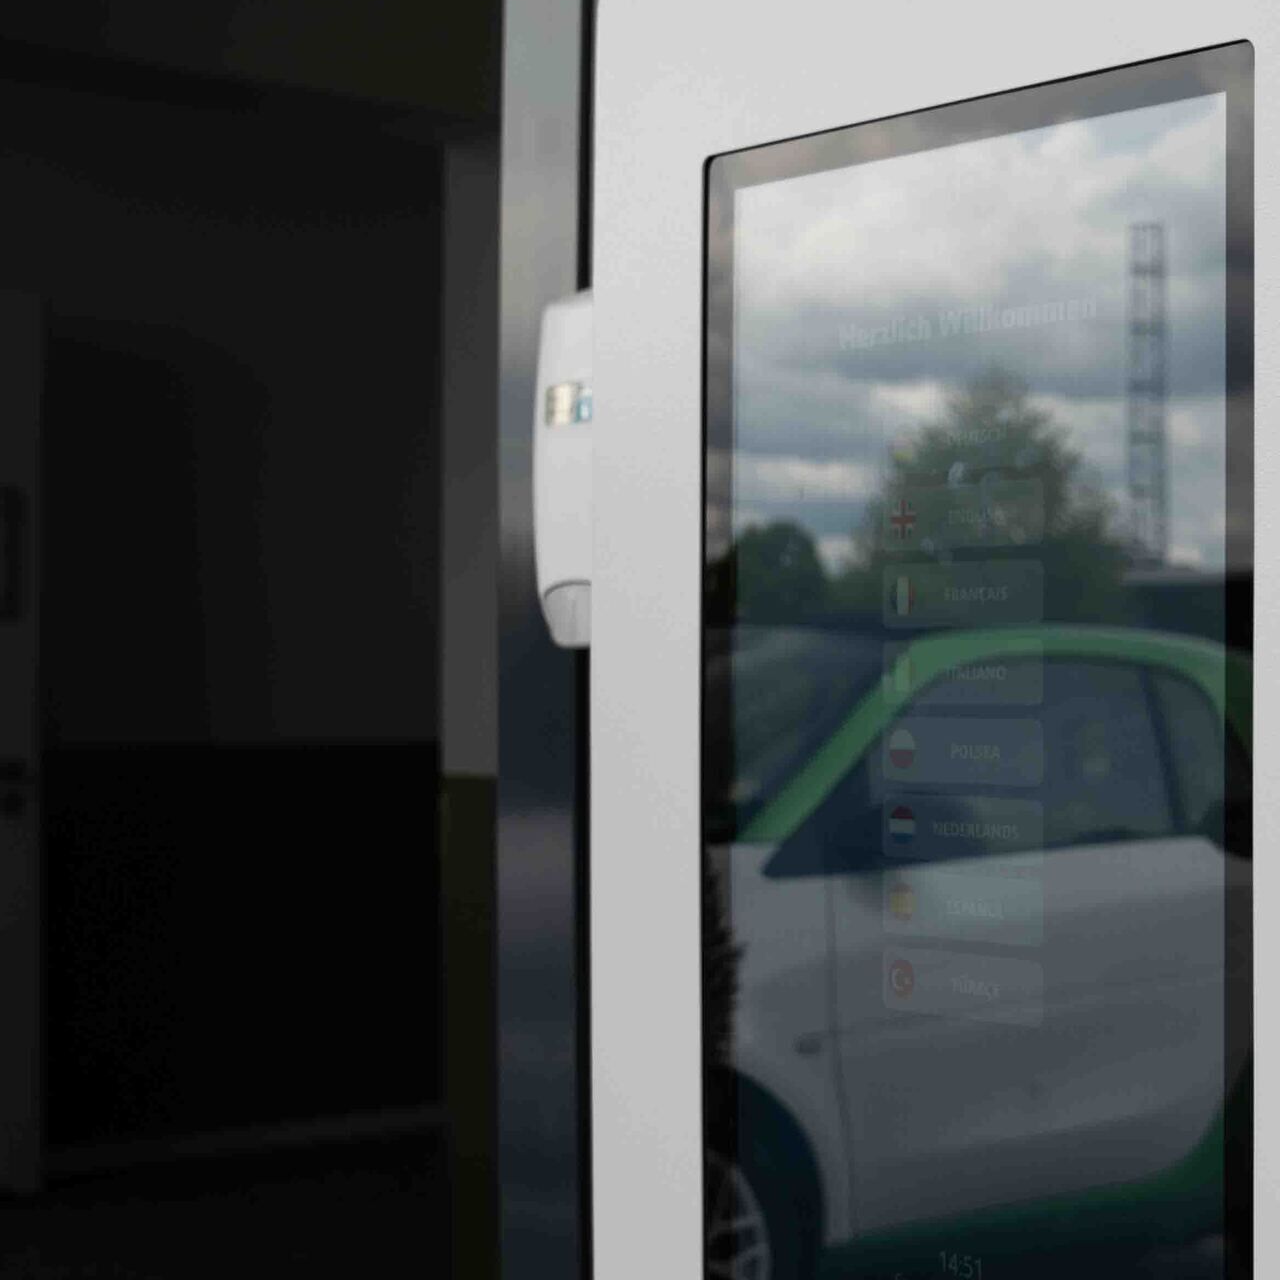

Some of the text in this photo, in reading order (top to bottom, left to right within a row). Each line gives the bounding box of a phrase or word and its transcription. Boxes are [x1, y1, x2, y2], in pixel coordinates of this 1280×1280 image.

[944, 585, 1008, 605] FRANÇAIS
[950, 742, 1000, 760] POLSKA
[932, 821, 1020, 839] NEDERLANDS
[939, 1250, 983, 1280] 14:51
